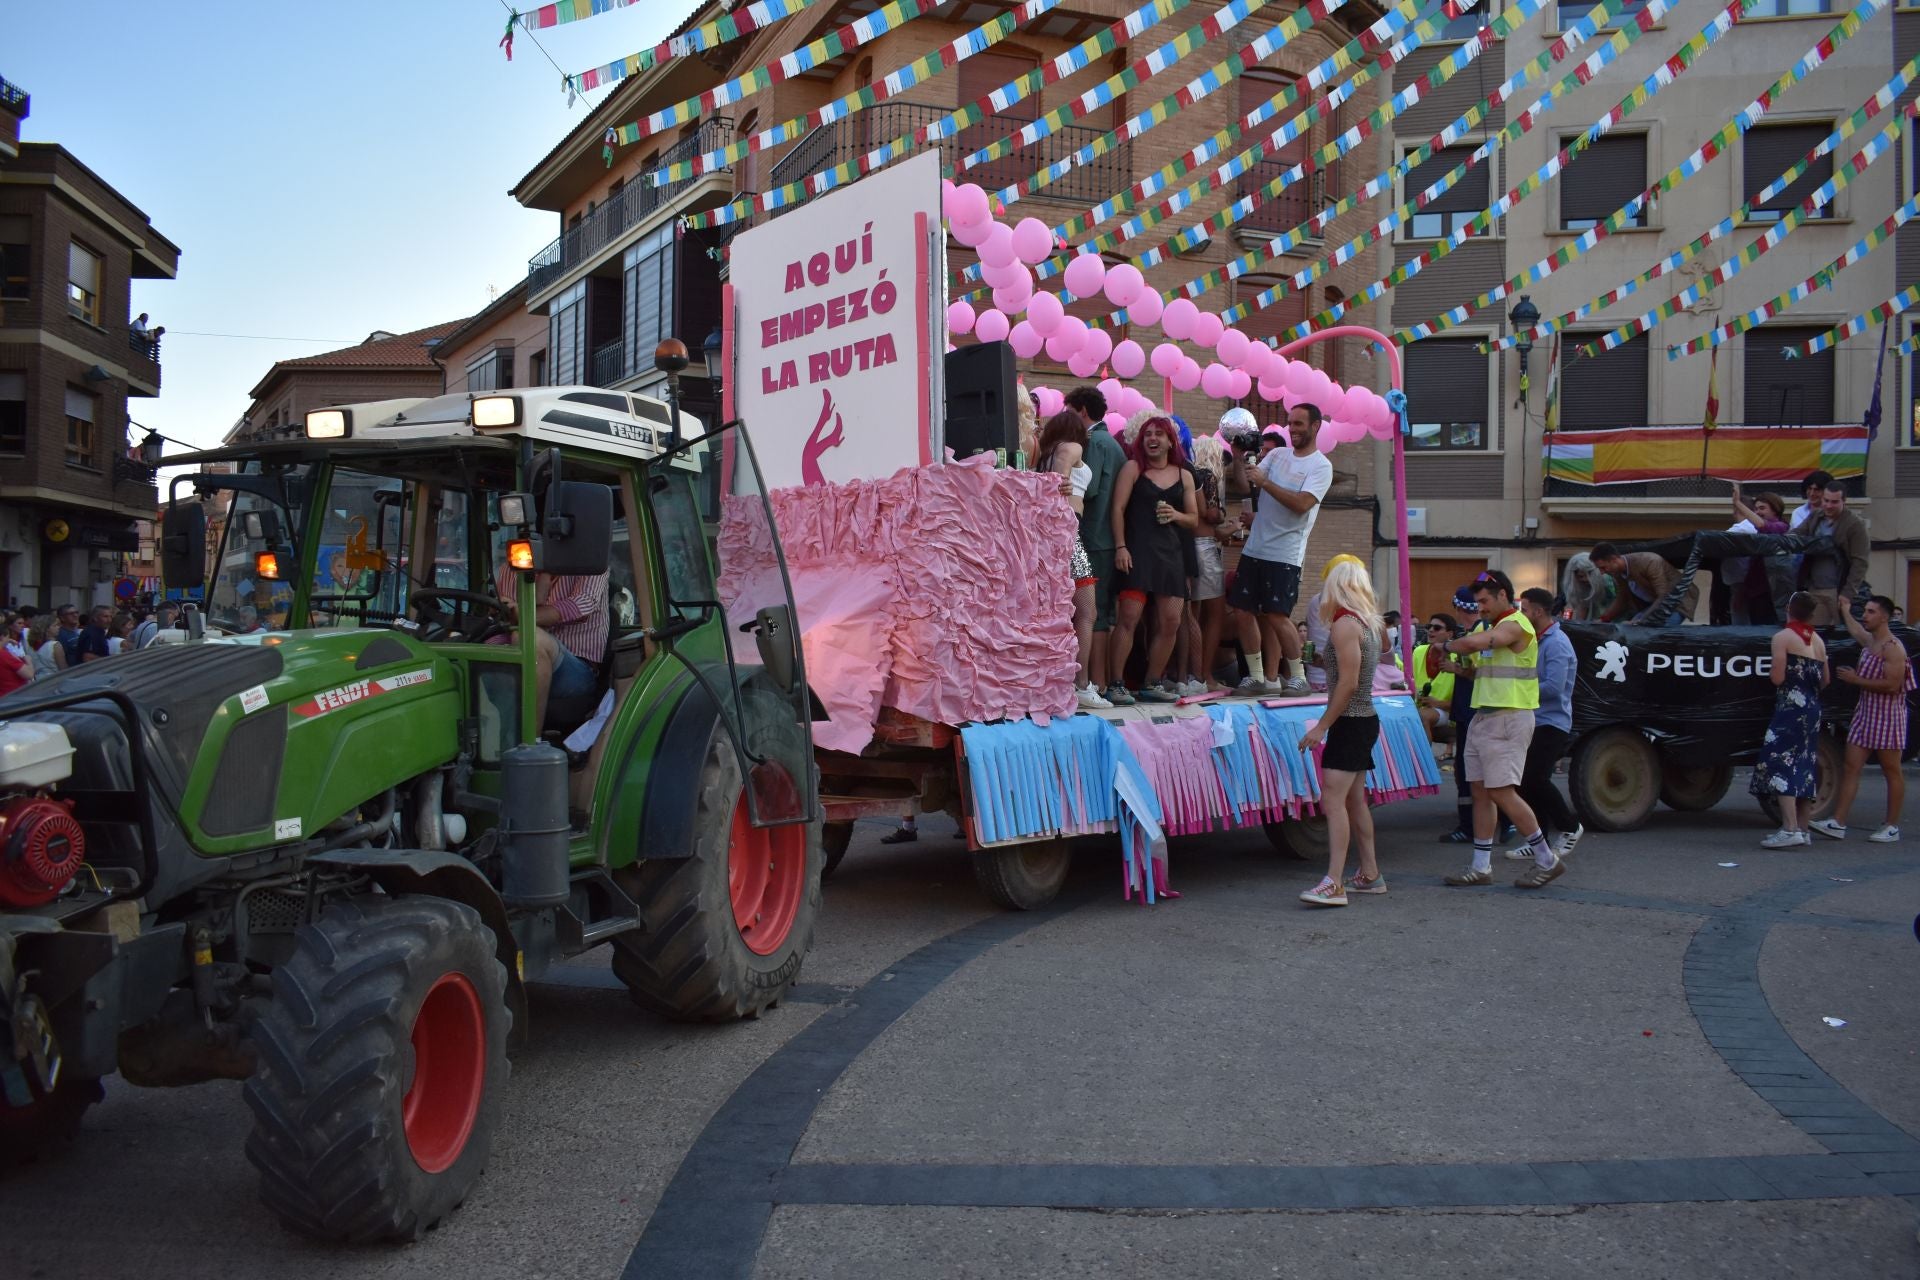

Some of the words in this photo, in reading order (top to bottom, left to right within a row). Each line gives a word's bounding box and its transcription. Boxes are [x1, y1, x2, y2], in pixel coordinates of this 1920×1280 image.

[784, 221, 873, 293] AQUÍ
[761, 268, 897, 348] EMPEZÓ
[761, 360, 799, 394] LA
[808, 333, 898, 384] RUTA
[608, 421, 652, 443] FENDT
[1647, 653, 1773, 678] PEUGE
[314, 679, 370, 711] FENDT
